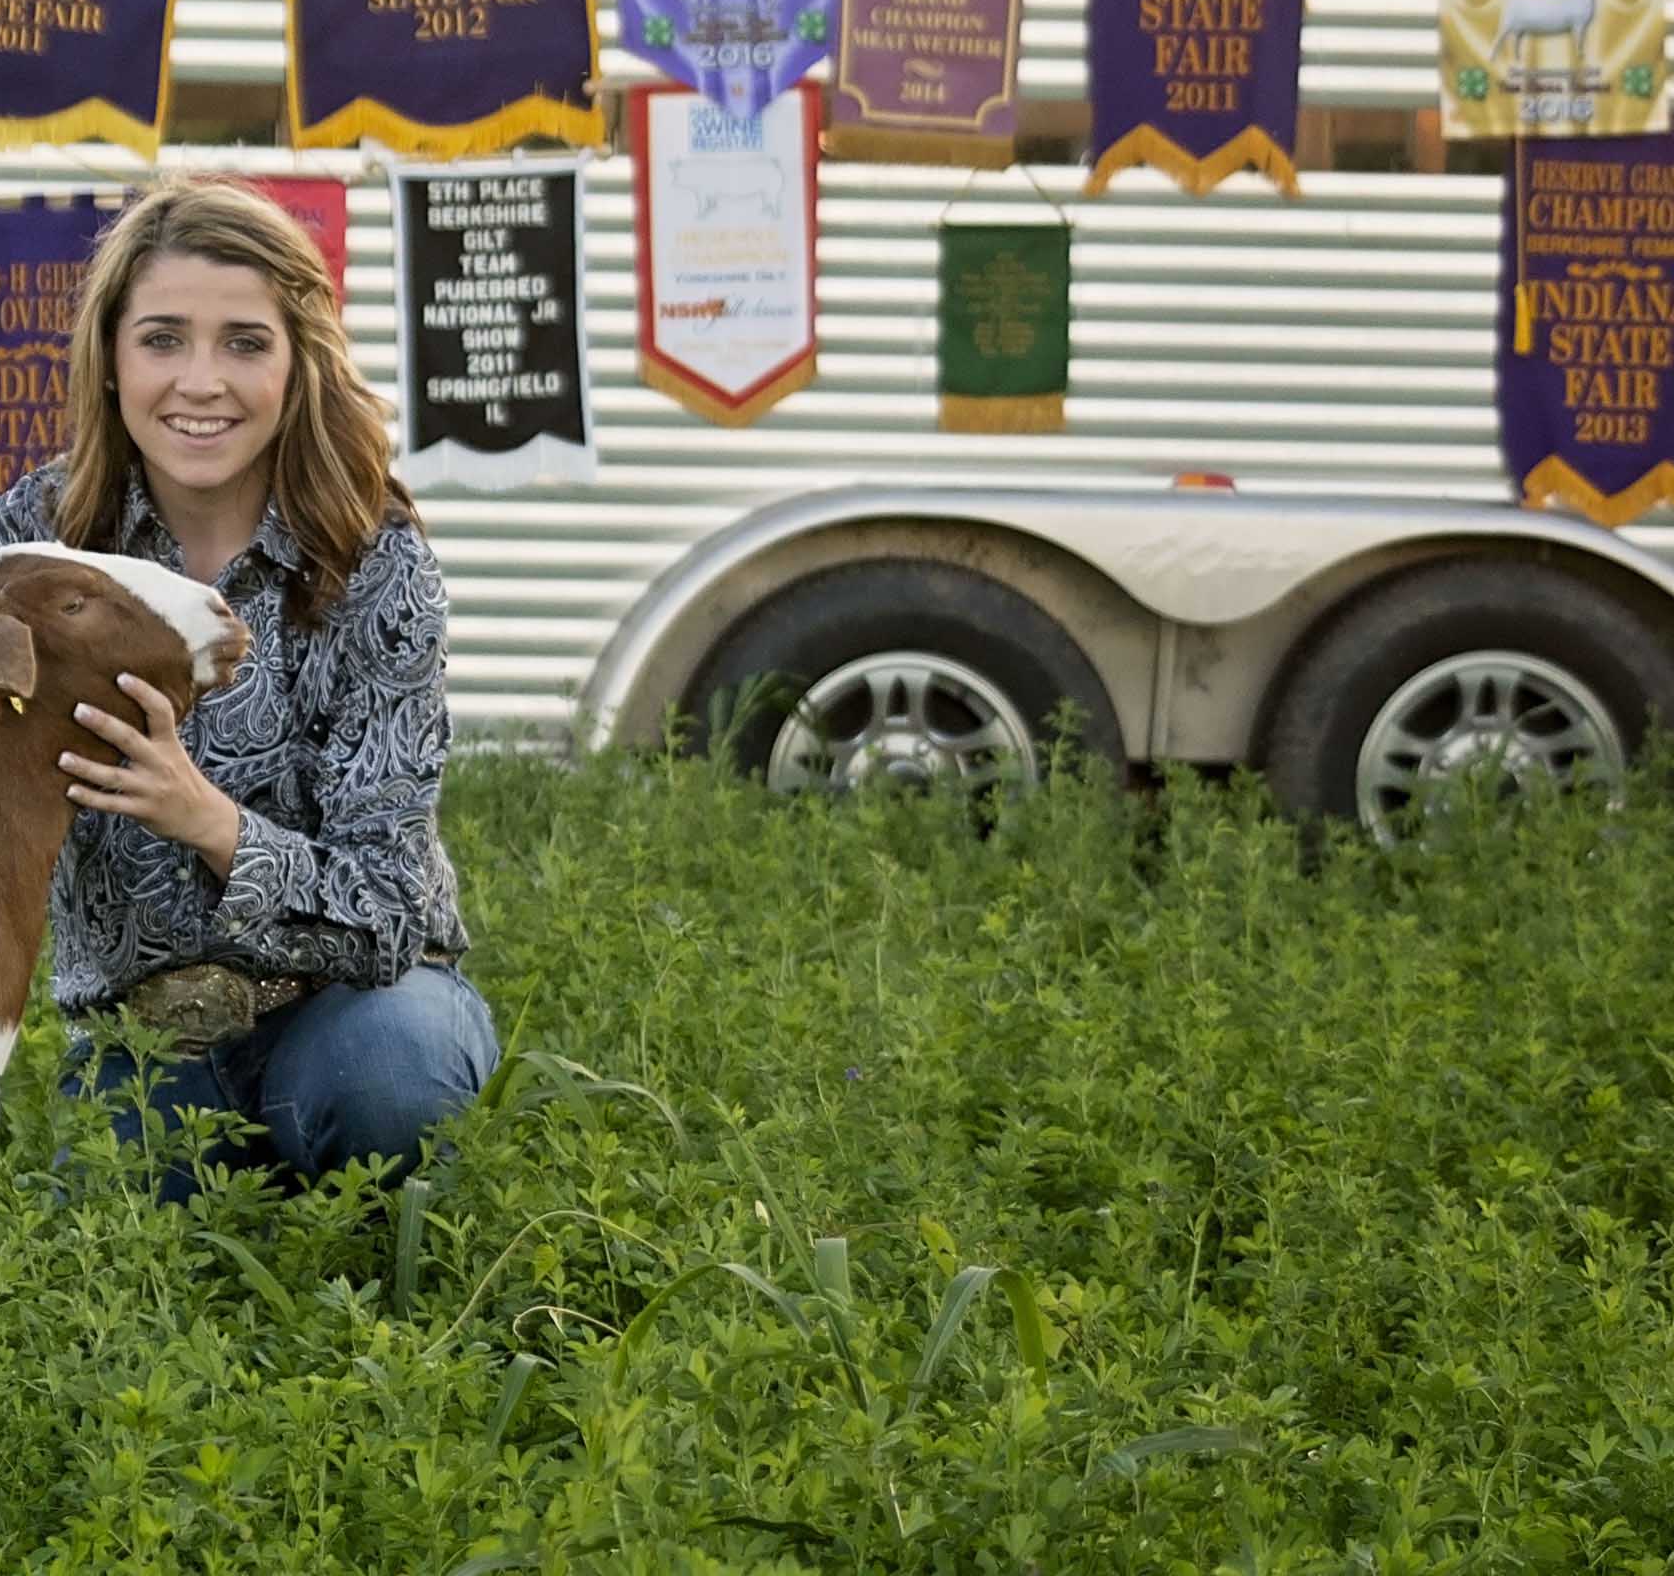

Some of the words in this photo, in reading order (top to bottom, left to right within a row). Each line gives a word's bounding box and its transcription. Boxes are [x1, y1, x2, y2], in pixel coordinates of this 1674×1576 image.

[34, 2, 106, 34] FAIR
[415, 8, 489, 40] 2012
[870, 6, 987, 31] CHAMPION
[853, 27, 906, 49] MEAT
[913, 32, 1001, 58] WETHER
[1154, 35, 1250, 76] FAIR
[900, 80, 947, 105] 2014
[1166, 81, 1238, 111] 2011
[1532, 160, 1624, 192] RESERVE
[428, 179, 470, 204] 5TH
[480, 178, 546, 199] PLACE
[428, 203, 547, 229] BERKSHIRE
[463, 229, 506, 250] GILT
[458, 253, 517, 275] TEAM
[434, 276, 547, 301] PUREBRED
[423, 304, 517, 328] NATIONAL
[531, 301, 558, 321] JR
[462, 328, 520, 349] SHOW
[1549, 326, 1674, 367] STATE
[467, 354, 514, 375] 2011
[427, 373, 561, 401] SPRINGFIELD
[1565, 368, 1658, 409] FAIR
[486, 403, 506, 423] IL
[1574, 413, 1649, 443] 2013
